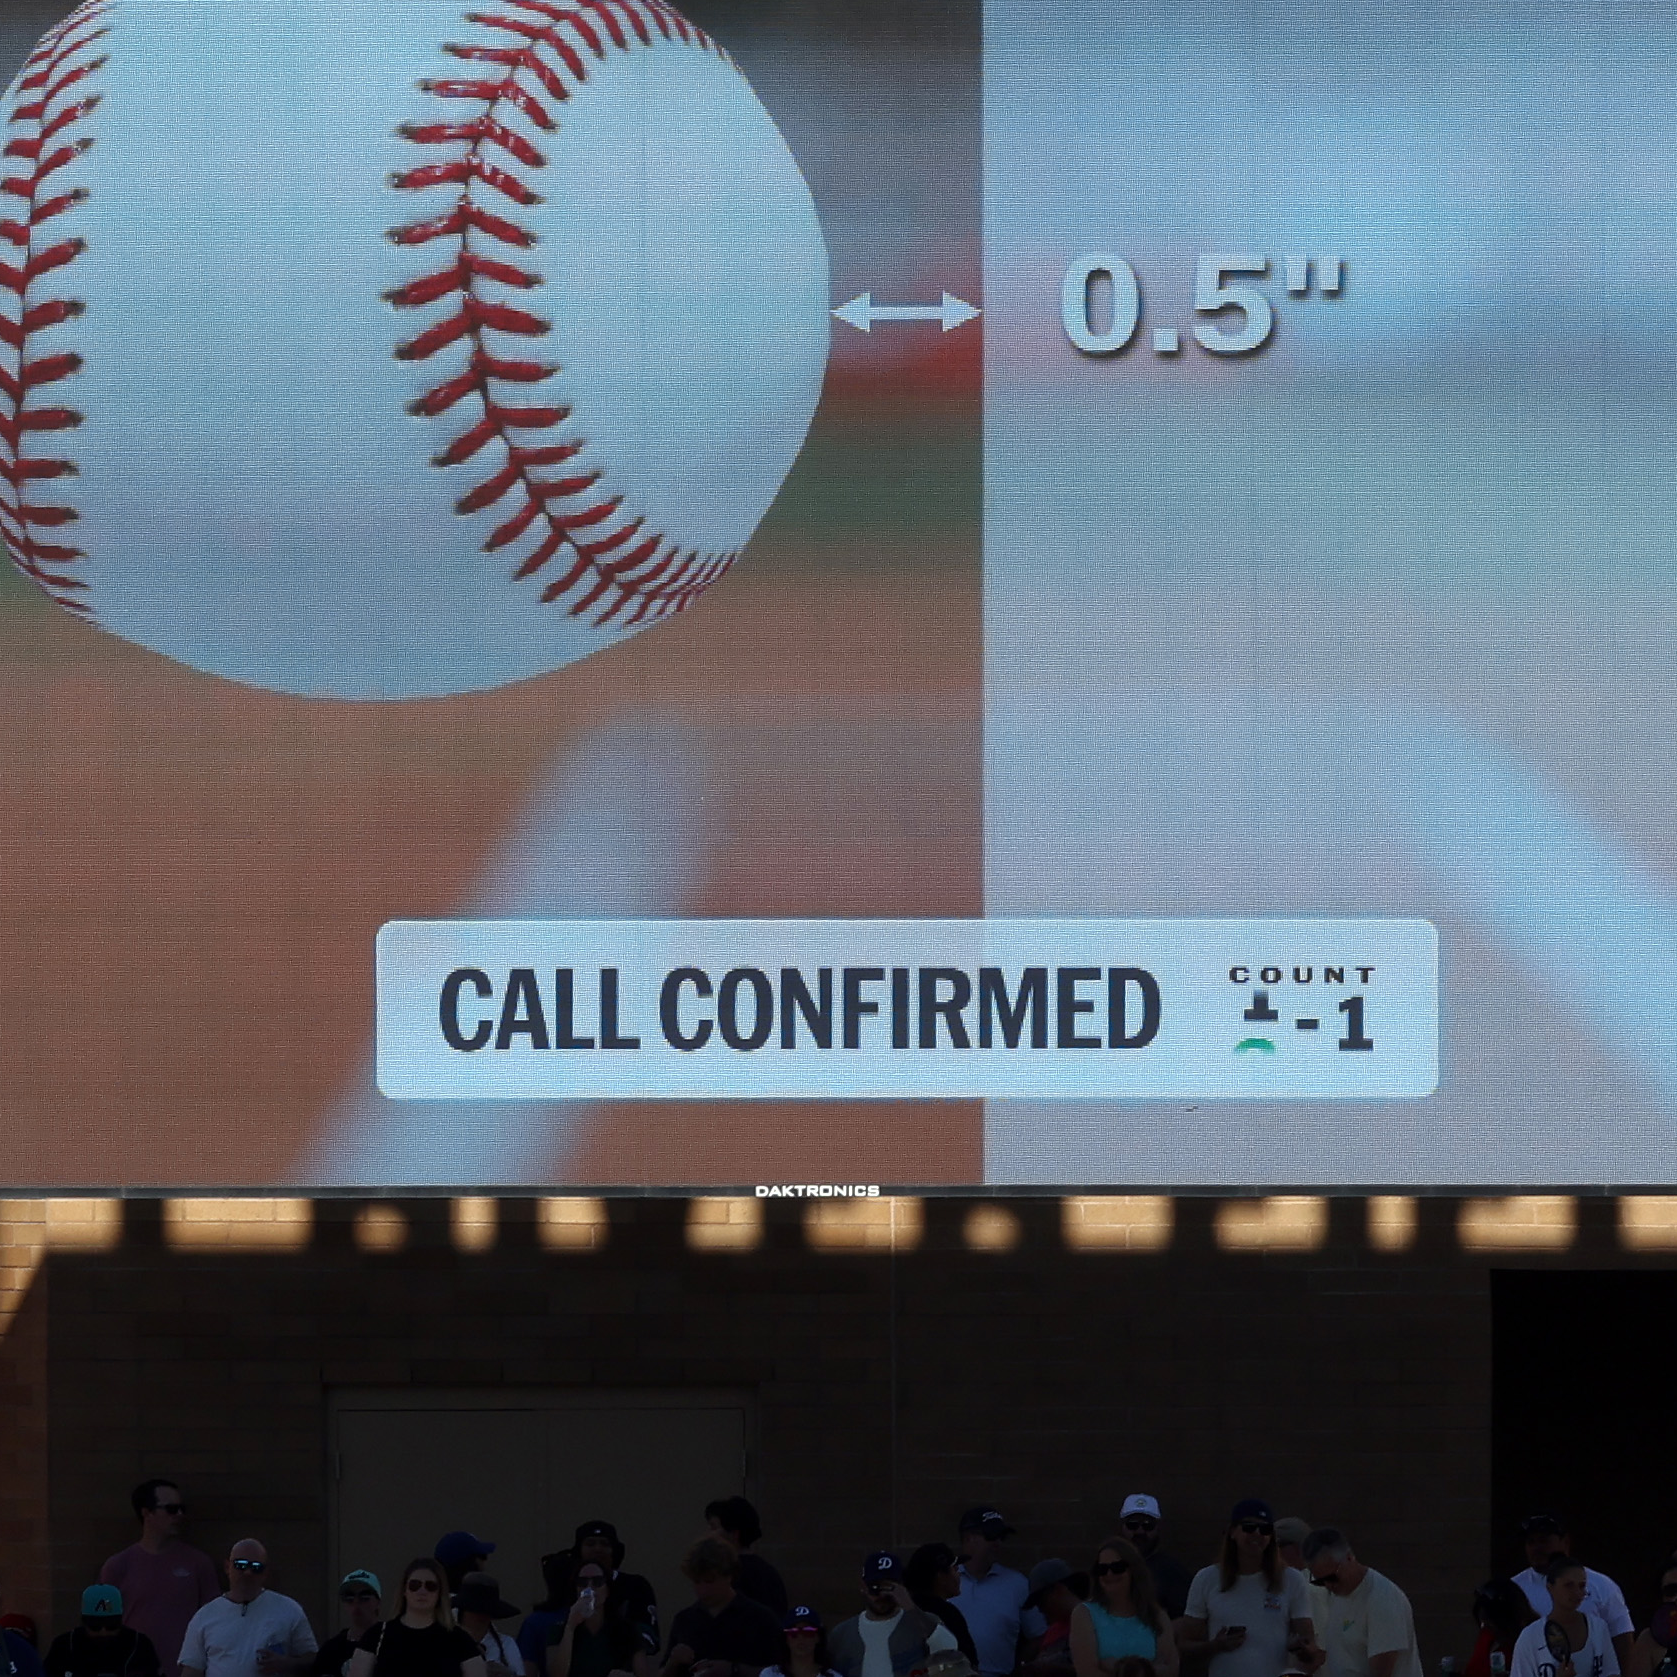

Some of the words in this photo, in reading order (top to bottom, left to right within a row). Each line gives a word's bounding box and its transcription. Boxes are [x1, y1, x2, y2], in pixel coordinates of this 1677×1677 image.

[1228, 966, 1377, 985] COUNT
[438, 967, 641, 1052] CALL
[659, 966, 1162, 1052] CONFIRMED
[755, 1184, 880, 1197] DAKTRONICS
